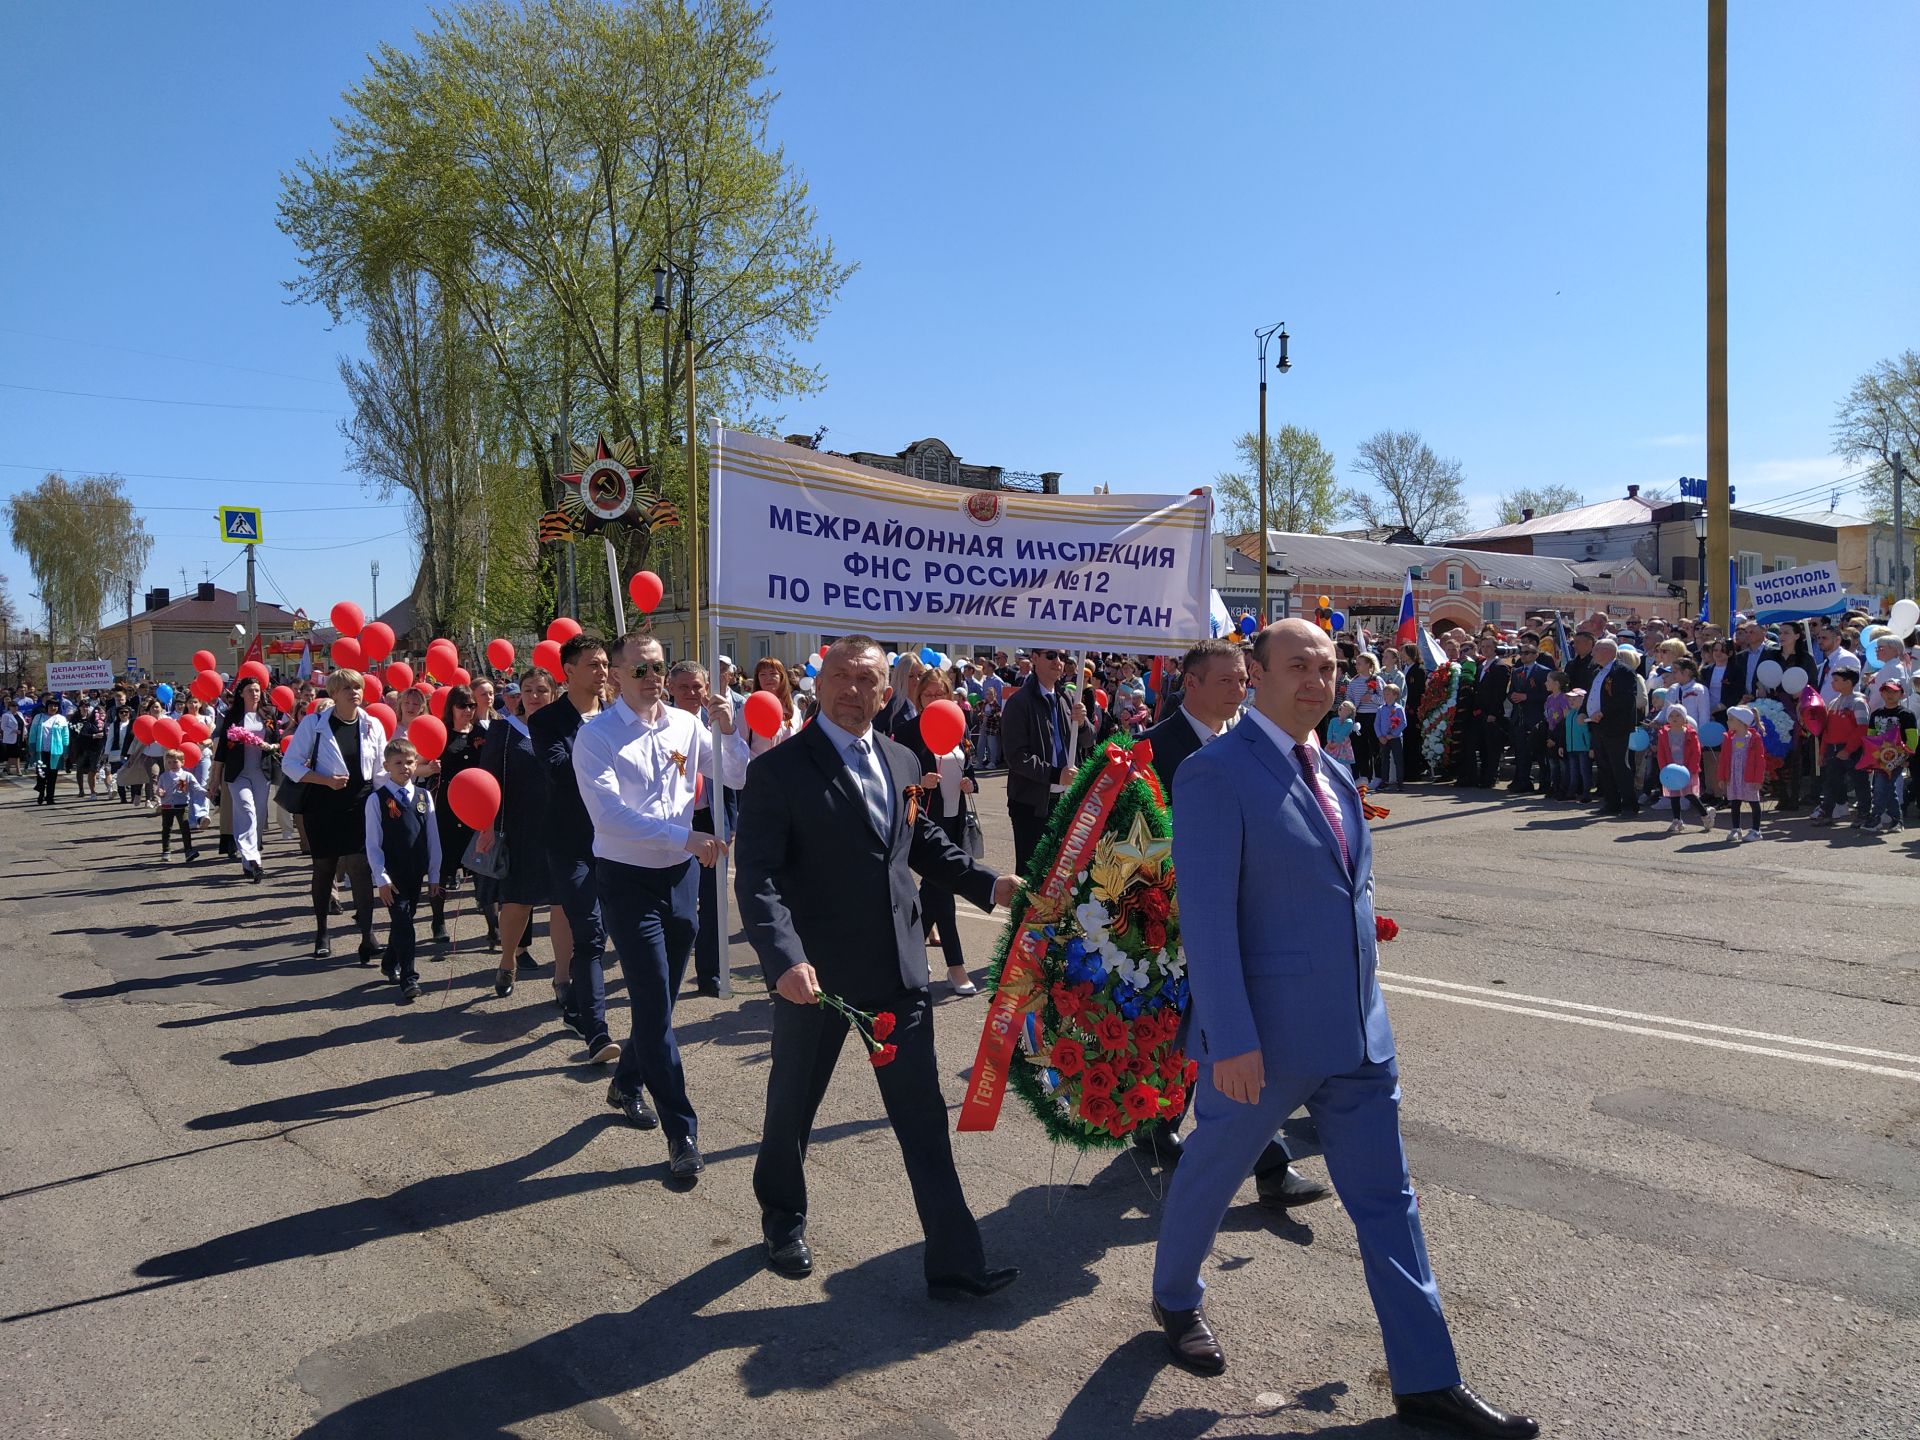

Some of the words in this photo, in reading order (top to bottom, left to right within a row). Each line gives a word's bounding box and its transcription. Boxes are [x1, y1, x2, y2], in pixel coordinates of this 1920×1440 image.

[582, 461, 626, 514] ОТЕЧЕСТВЕННАЯ
[1680, 476, 1736, 504] SAMG
[769, 504, 1003, 558] МЕЖРАЙОННАЯ
[1016, 539, 1175, 569] ИНСПЕКЦИЯ
[844, 552, 911, 582] ФНС
[924, 561, 1048, 589] РОССИИ
[1053, 570, 1110, 593] №12
[1754, 569, 1830, 591] ЧИСТОПОЛЬ
[768, 574, 810, 603] ПО
[823, 582, 1018, 618] РЕСПУБЛИКЕ
[1027, 597, 1172, 628] ТАТАРСТАН
[1755, 582, 1837, 606] ВОДОКАНАЛ
[1230, 604, 1257, 617] кафе
[51, 671, 109, 680] КАЗНАЧЕЙСТВА
[52, 664, 106, 673] ДЕПАРТАМЕНТ
